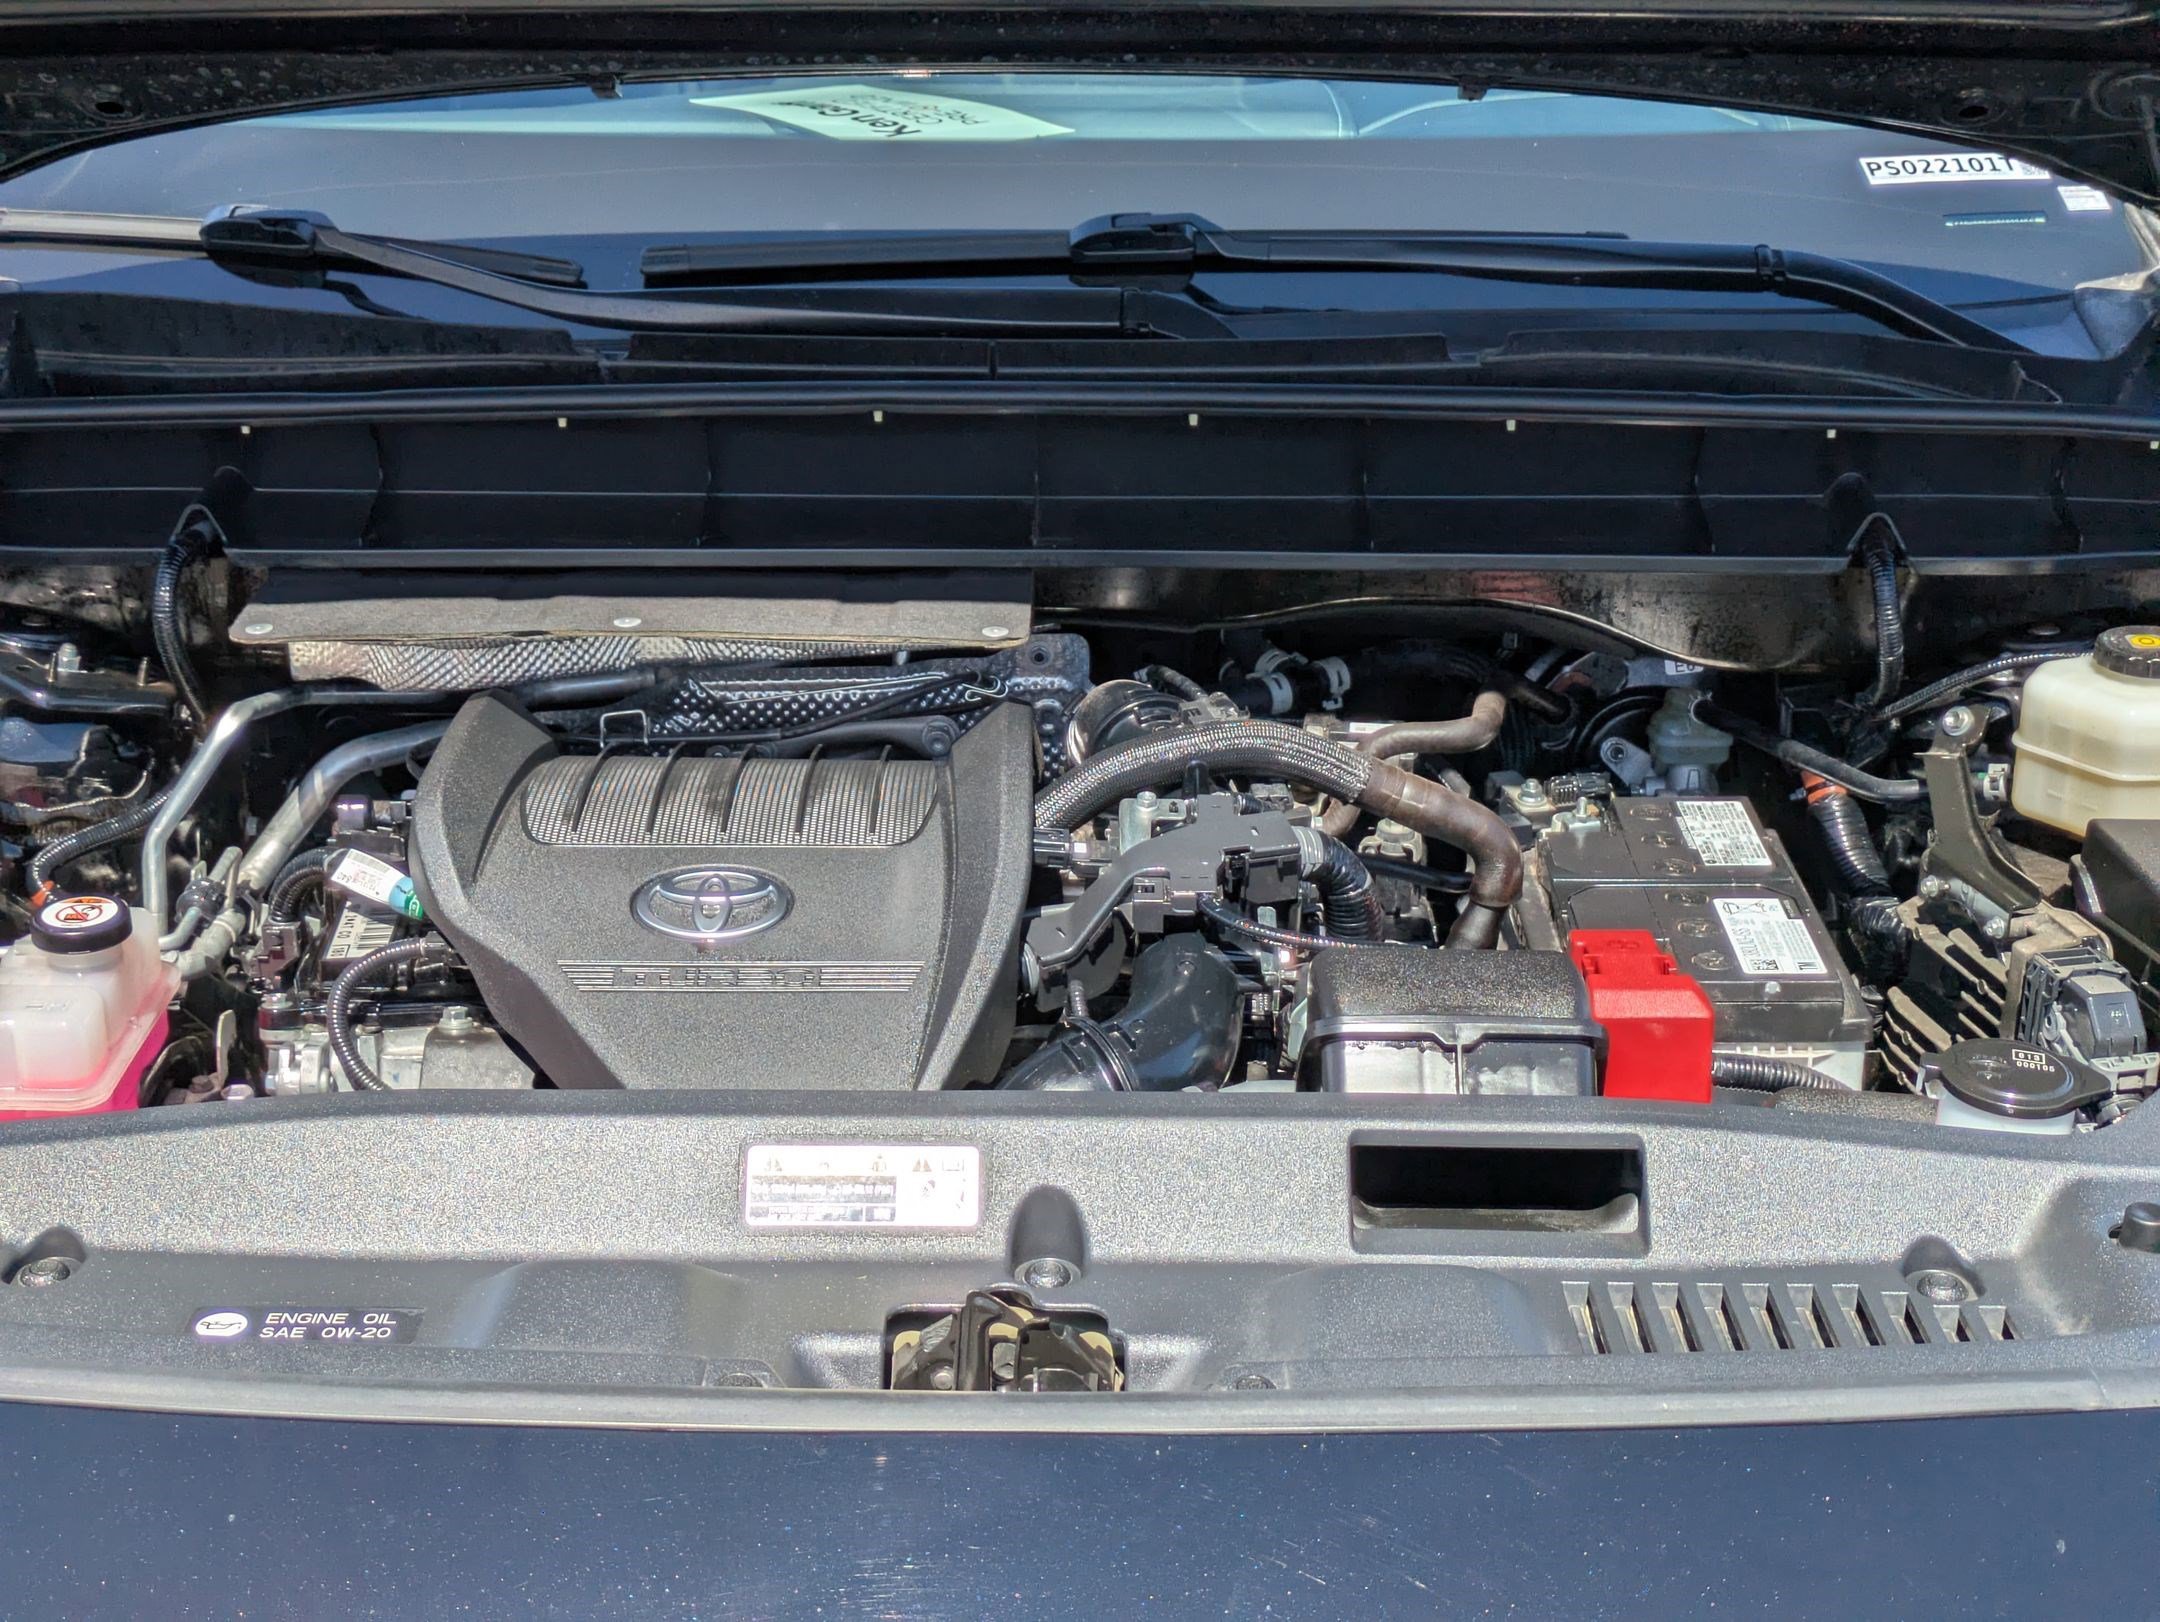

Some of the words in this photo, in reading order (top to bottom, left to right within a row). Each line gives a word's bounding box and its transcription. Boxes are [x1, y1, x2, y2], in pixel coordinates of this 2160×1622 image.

[850, 114, 922, 137] Ken
[620, 967, 815, 987] TURBO
[264, 1312, 349, 1325] ENGINE
[362, 1313, 397, 1325] OIL
[259, 1326, 307, 1338] SAE
[320, 1326, 392, 1338] 0W-20
